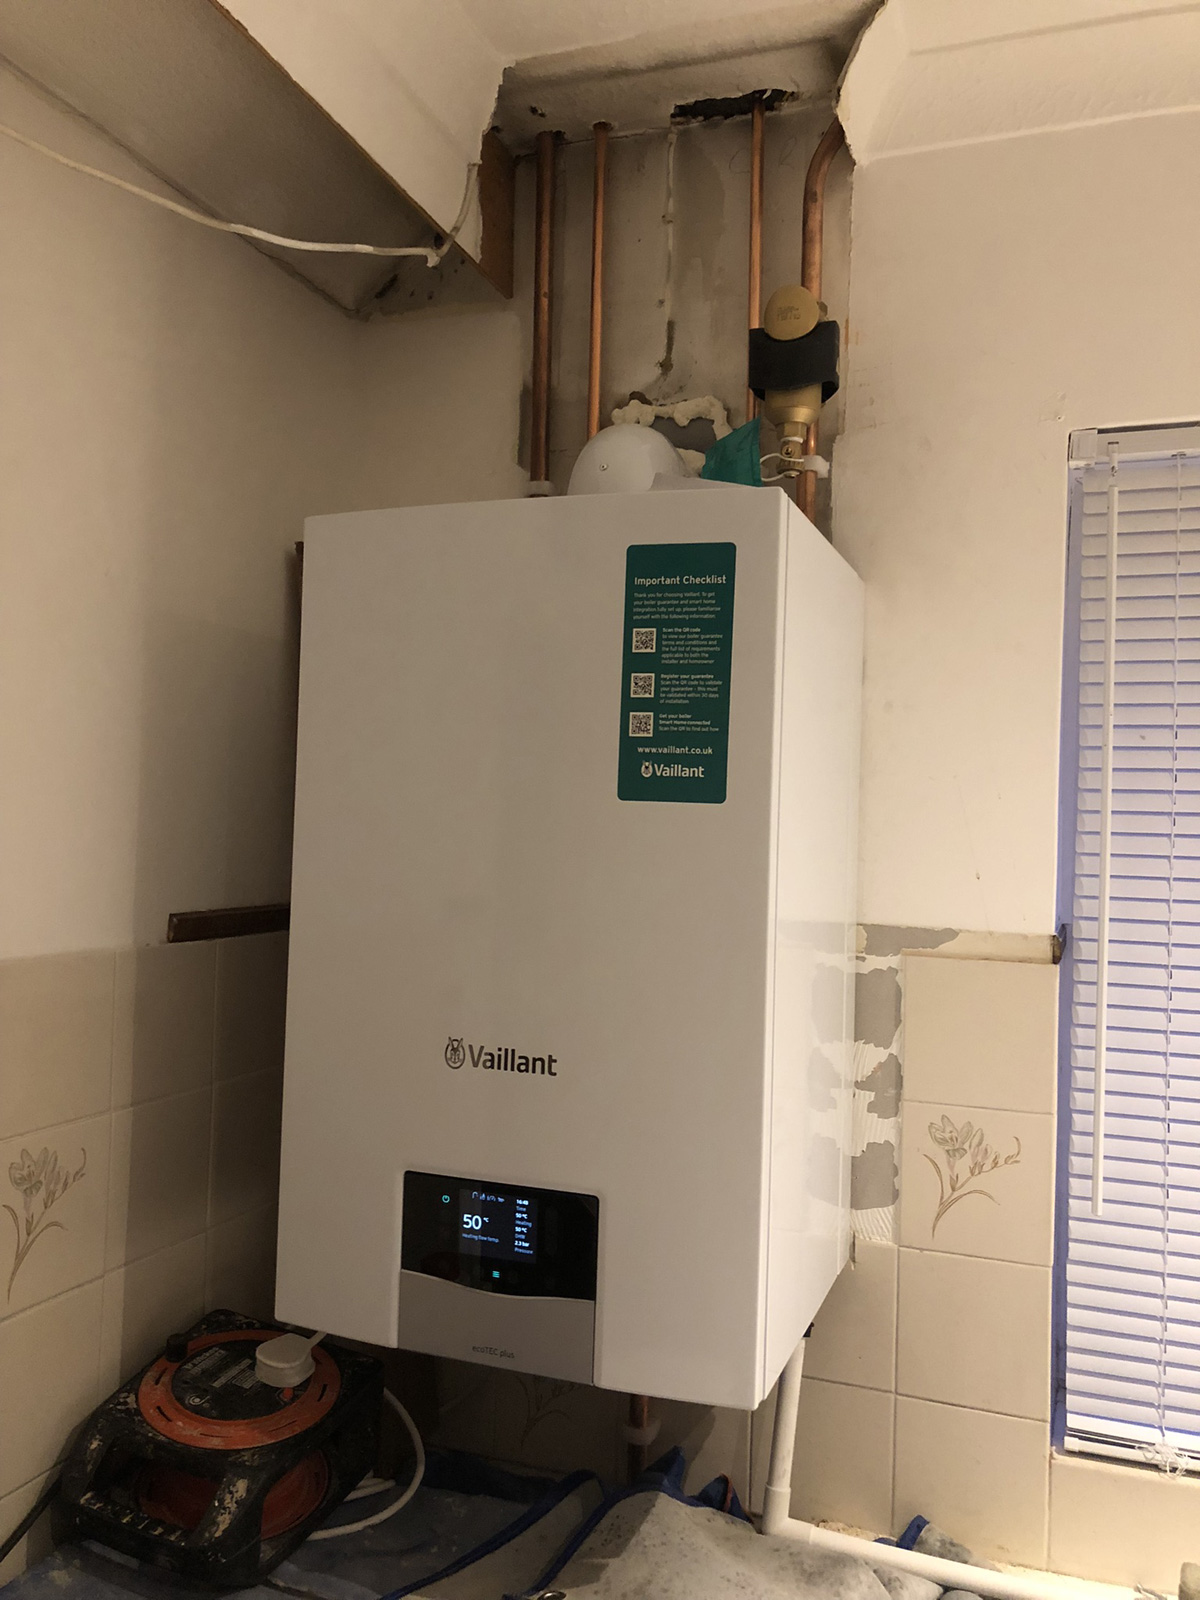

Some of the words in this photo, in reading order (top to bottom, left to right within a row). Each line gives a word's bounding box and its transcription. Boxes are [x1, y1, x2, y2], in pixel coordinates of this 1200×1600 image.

[634, 575, 680, 587] Important
[683, 574, 727, 584] Checklist
[637, 745, 713, 755] www.vaillant.co.uk
[654, 763, 705, 778] Vaillant
[468, 1044, 558, 1076] Vaillant
[462, 1213, 482, 1230] 50
[472, 1346, 498, 1355] ecoTEC
[500, 1350, 515, 1358] plus
